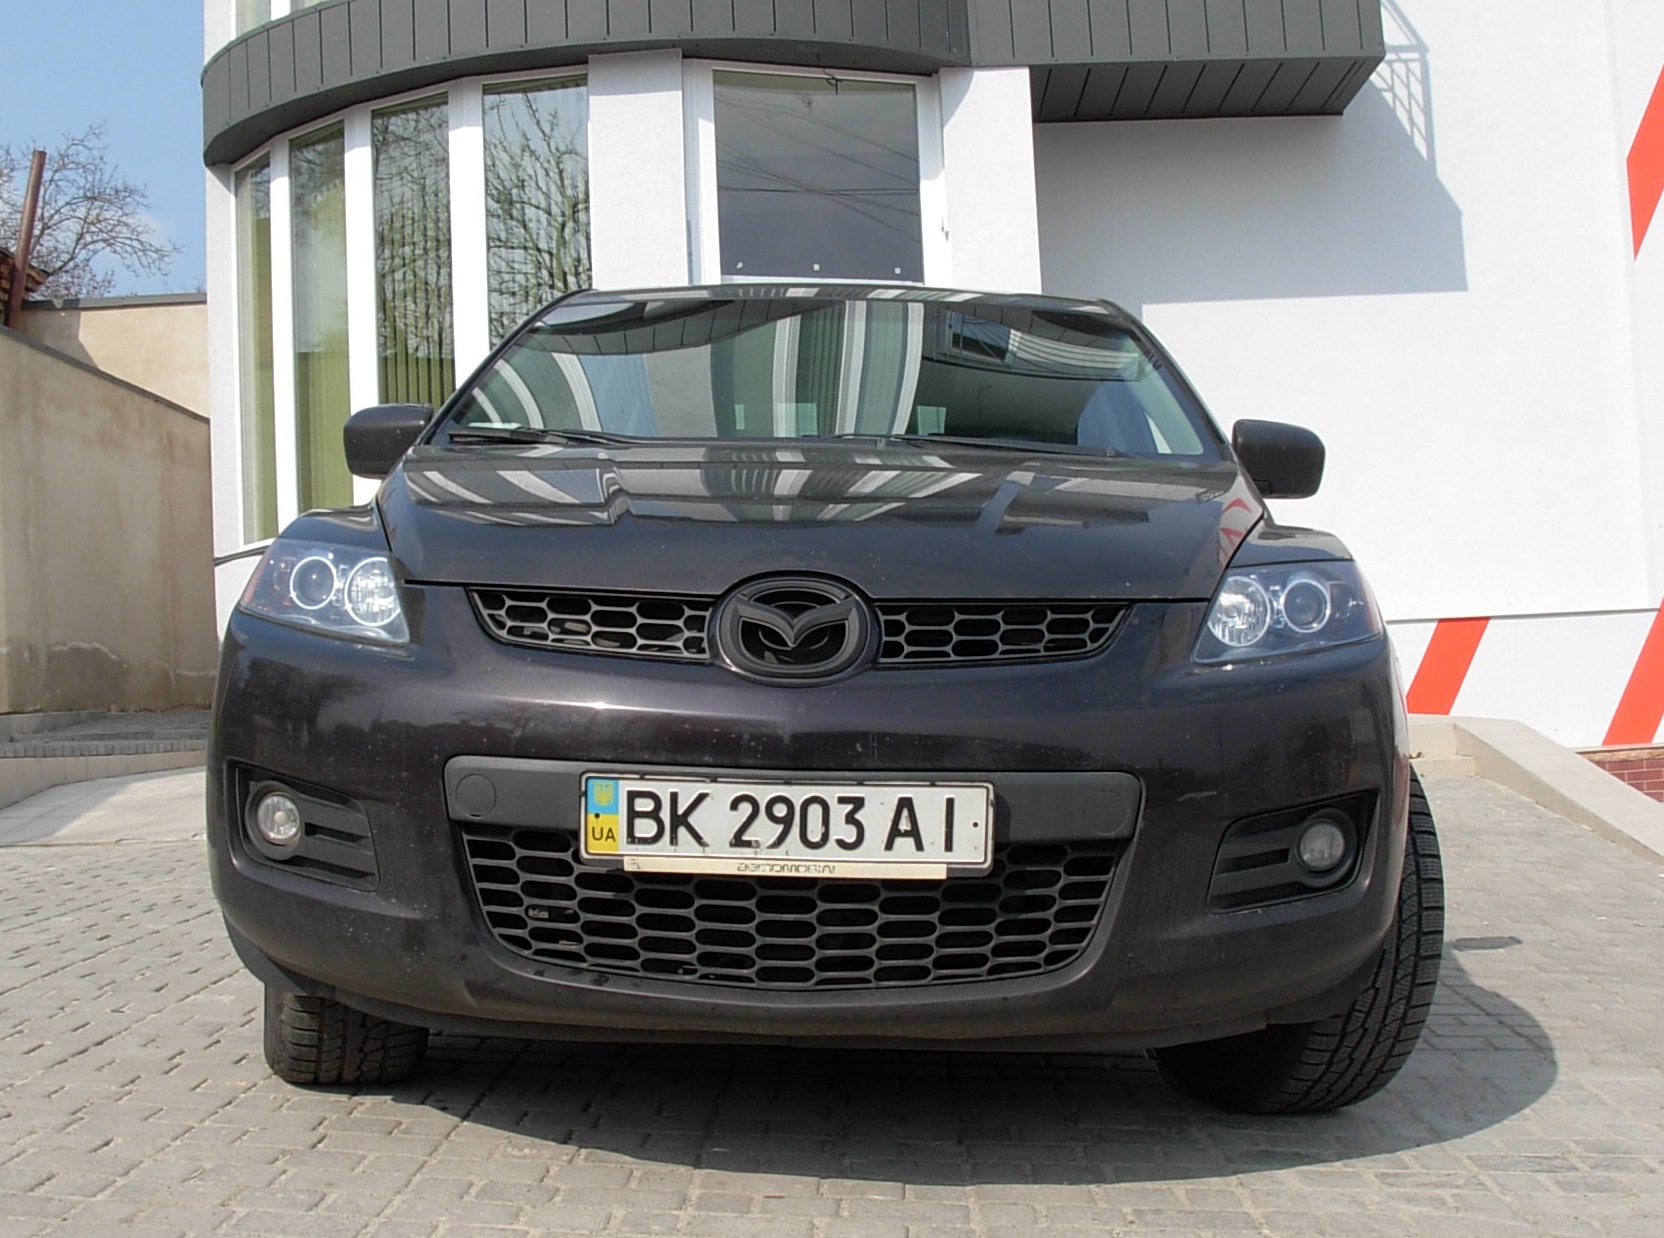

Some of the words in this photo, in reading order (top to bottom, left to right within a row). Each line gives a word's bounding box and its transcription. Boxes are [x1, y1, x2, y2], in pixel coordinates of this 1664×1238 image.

[591, 826, 617, 842] UA
[625, 789, 710, 848] BK
[728, 794, 866, 851] 2903
[883, 796, 955, 853] AI
